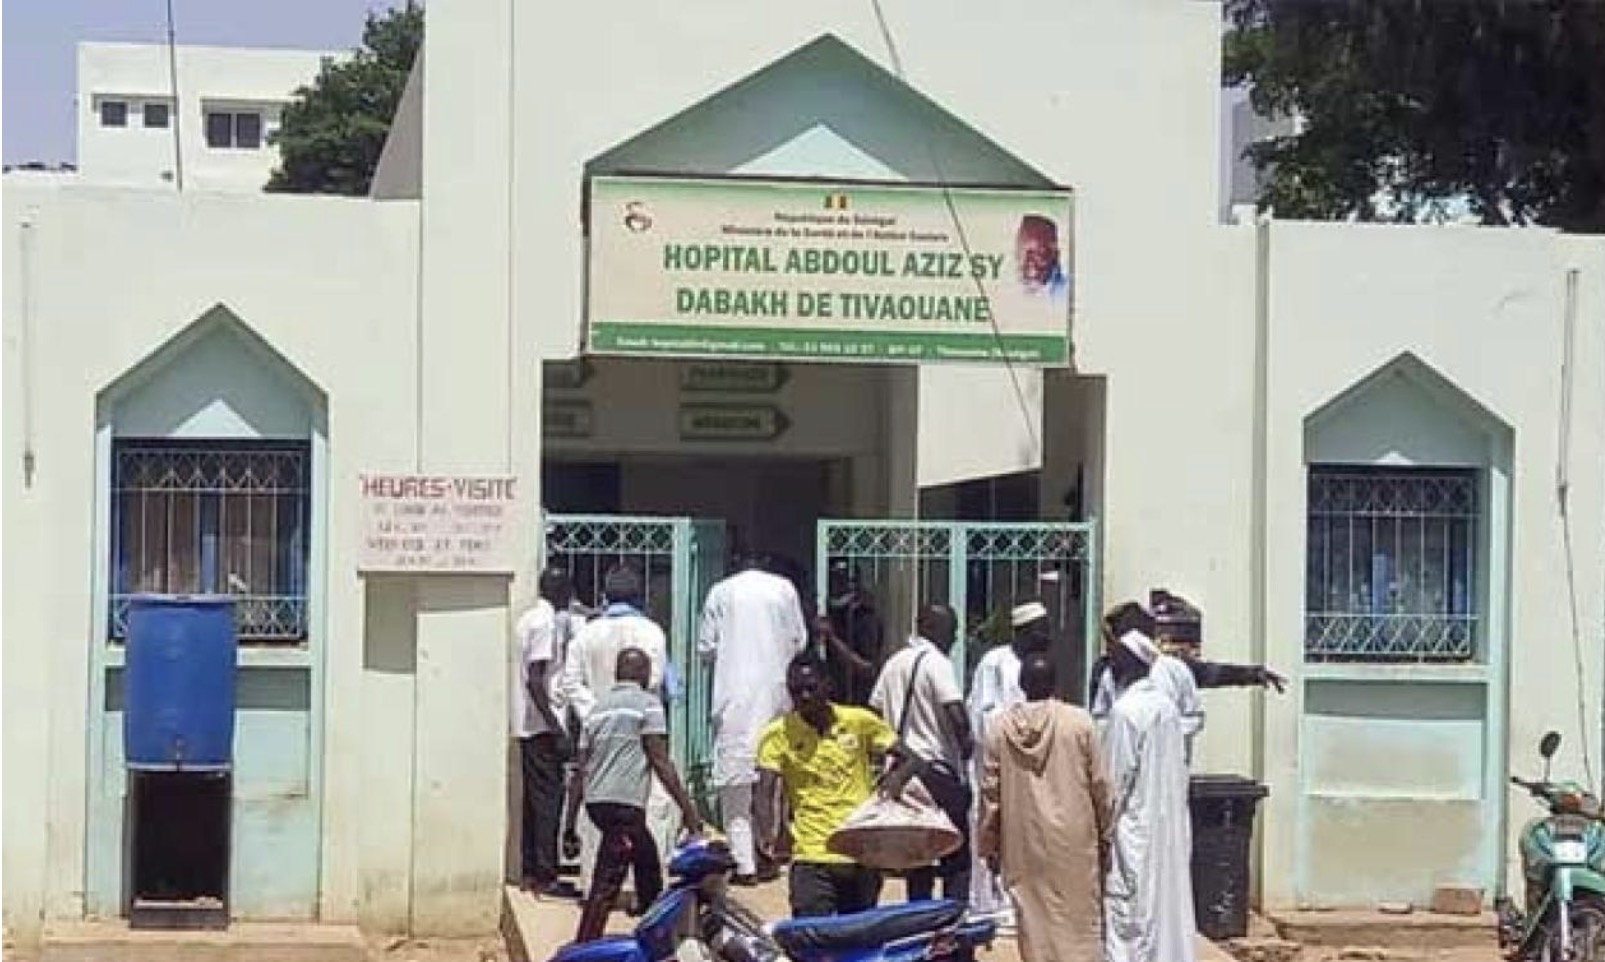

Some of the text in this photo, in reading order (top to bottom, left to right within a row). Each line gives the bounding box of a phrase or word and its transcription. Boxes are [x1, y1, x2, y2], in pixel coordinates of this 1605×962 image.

[663, 244, 1004, 279] HOPITAL ABDOUL AZIZ SY
[676, 287, 990, 323] DABAKH DE TIVAOUANE
